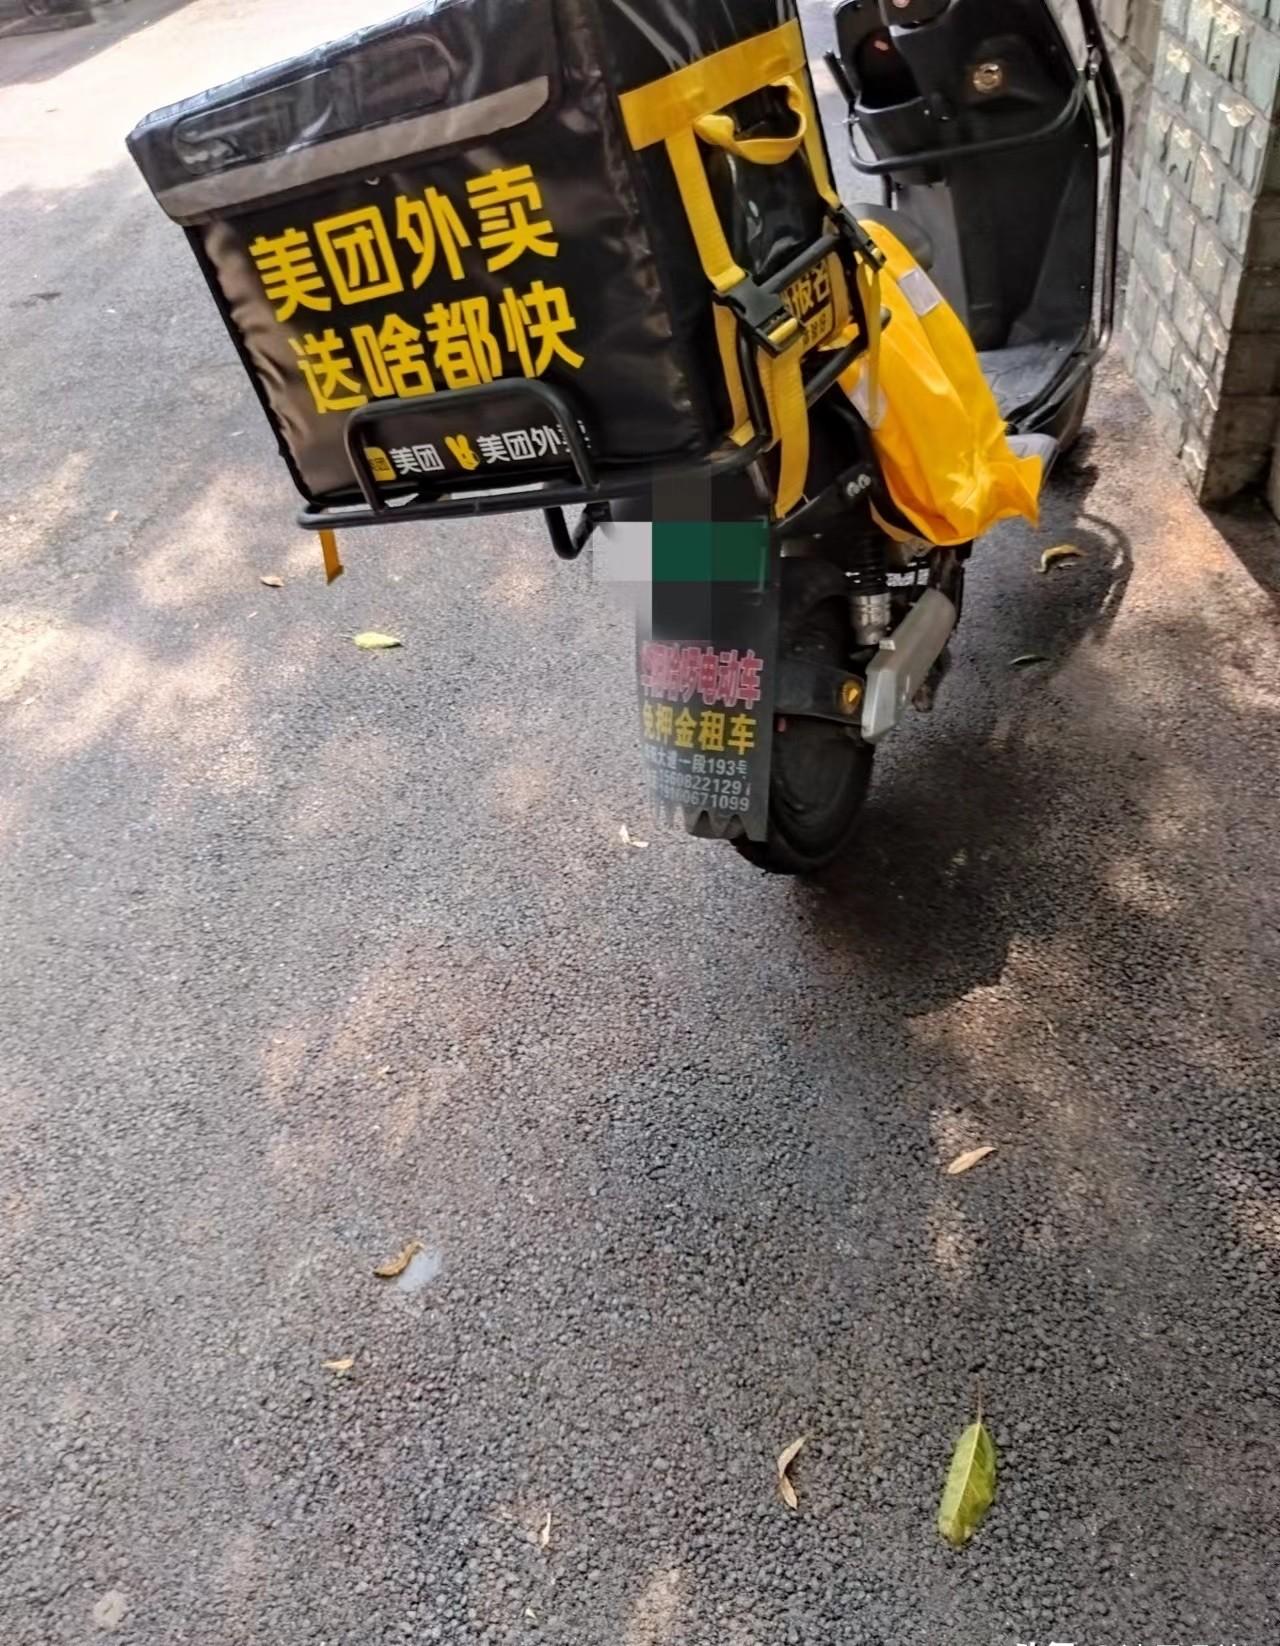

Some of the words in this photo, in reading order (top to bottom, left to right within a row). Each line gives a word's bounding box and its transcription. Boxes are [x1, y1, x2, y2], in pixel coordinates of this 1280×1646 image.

[249, 164, 558, 322] 美团外卖
[288, 280, 584, 413] 送啥都快
[388, 443, 445, 475] 美团
